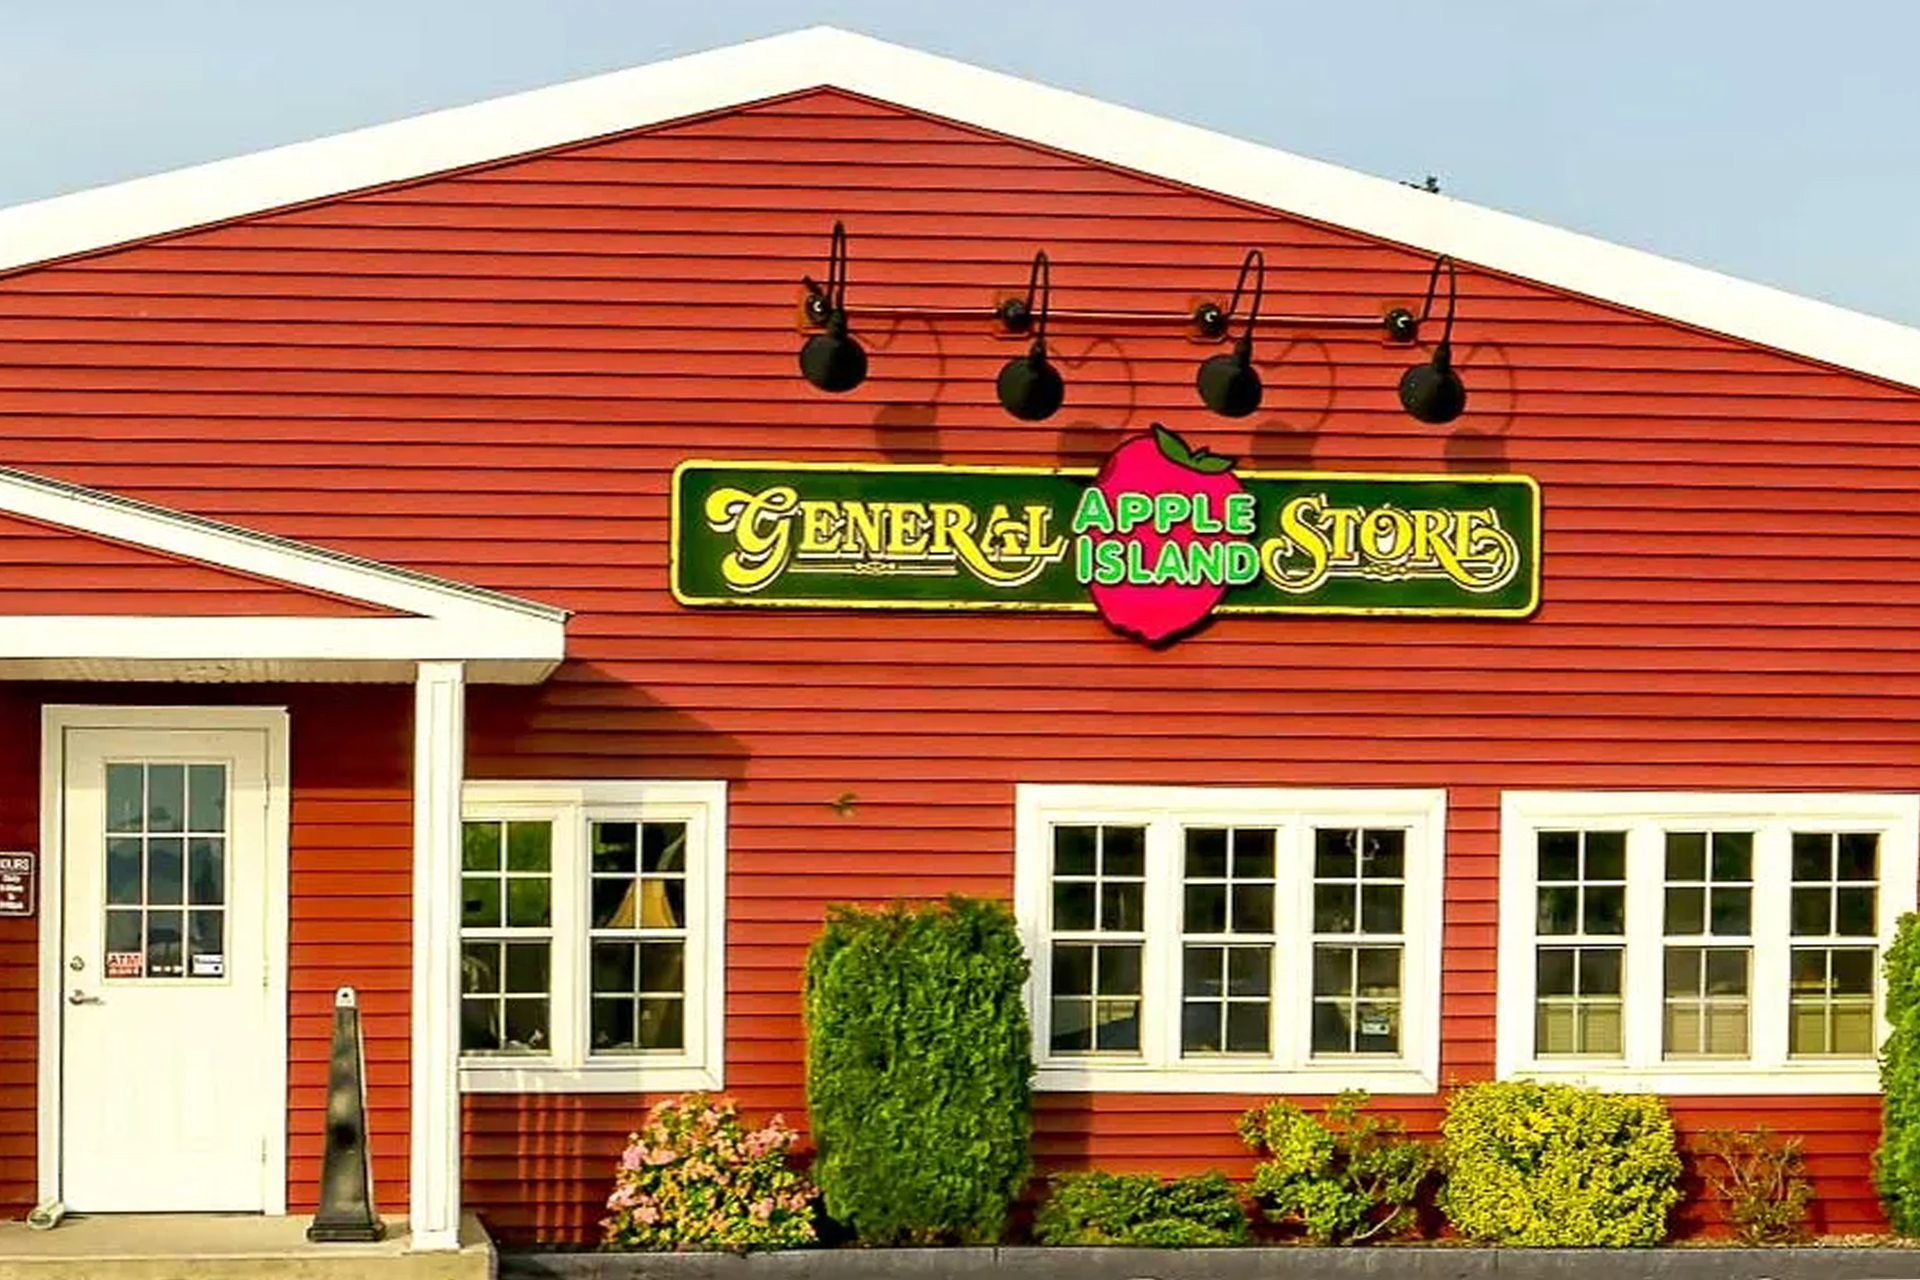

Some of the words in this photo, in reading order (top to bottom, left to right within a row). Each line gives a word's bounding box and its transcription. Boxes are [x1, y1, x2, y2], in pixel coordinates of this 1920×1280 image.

[1072, 487, 1256, 534] APPLE
[705, 486, 1068, 592] GENERAL
[1260, 493, 1519, 592] STORE
[1076, 535, 1260, 585] ISLAND
[108, 954, 140, 965] ATM
